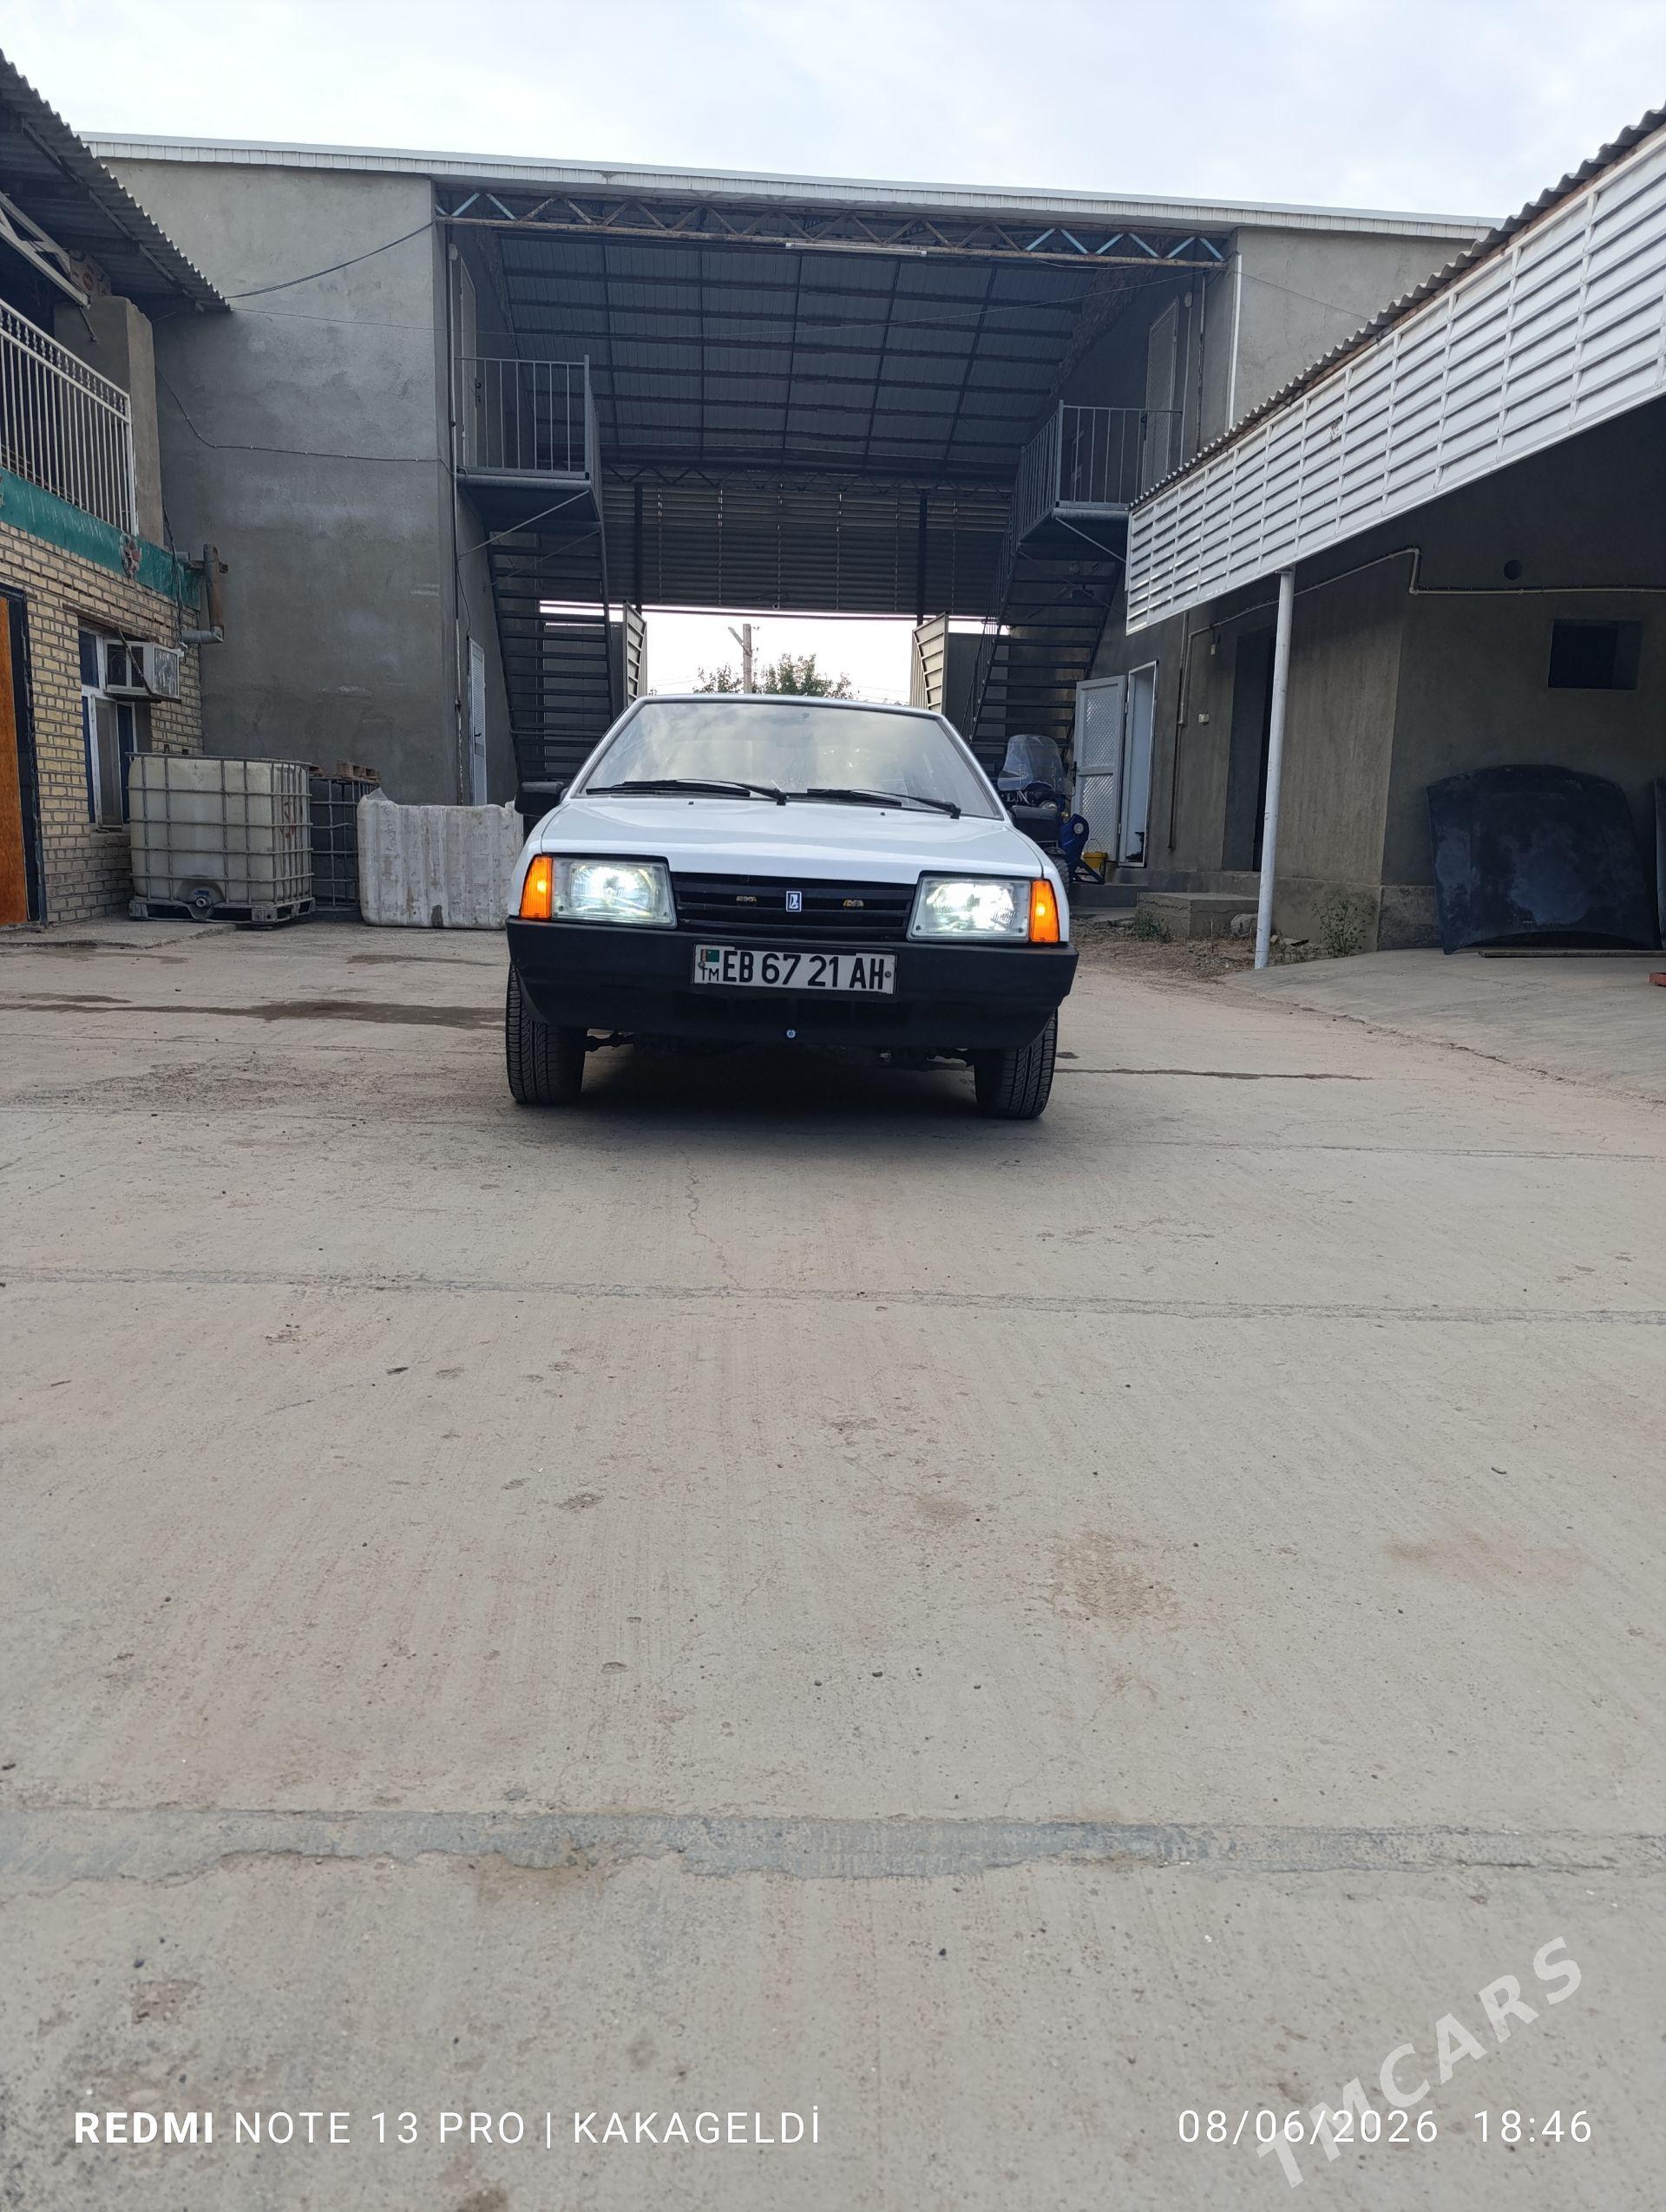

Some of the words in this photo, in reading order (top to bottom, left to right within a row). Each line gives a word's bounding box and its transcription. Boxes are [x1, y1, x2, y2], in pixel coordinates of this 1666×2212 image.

[699, 966, 719, 982] TM
[722, 950, 754, 984] EB
[761, 952, 802, 985] 67
[807, 955, 840, 988] 21
[849, 957, 885, 991] AH
